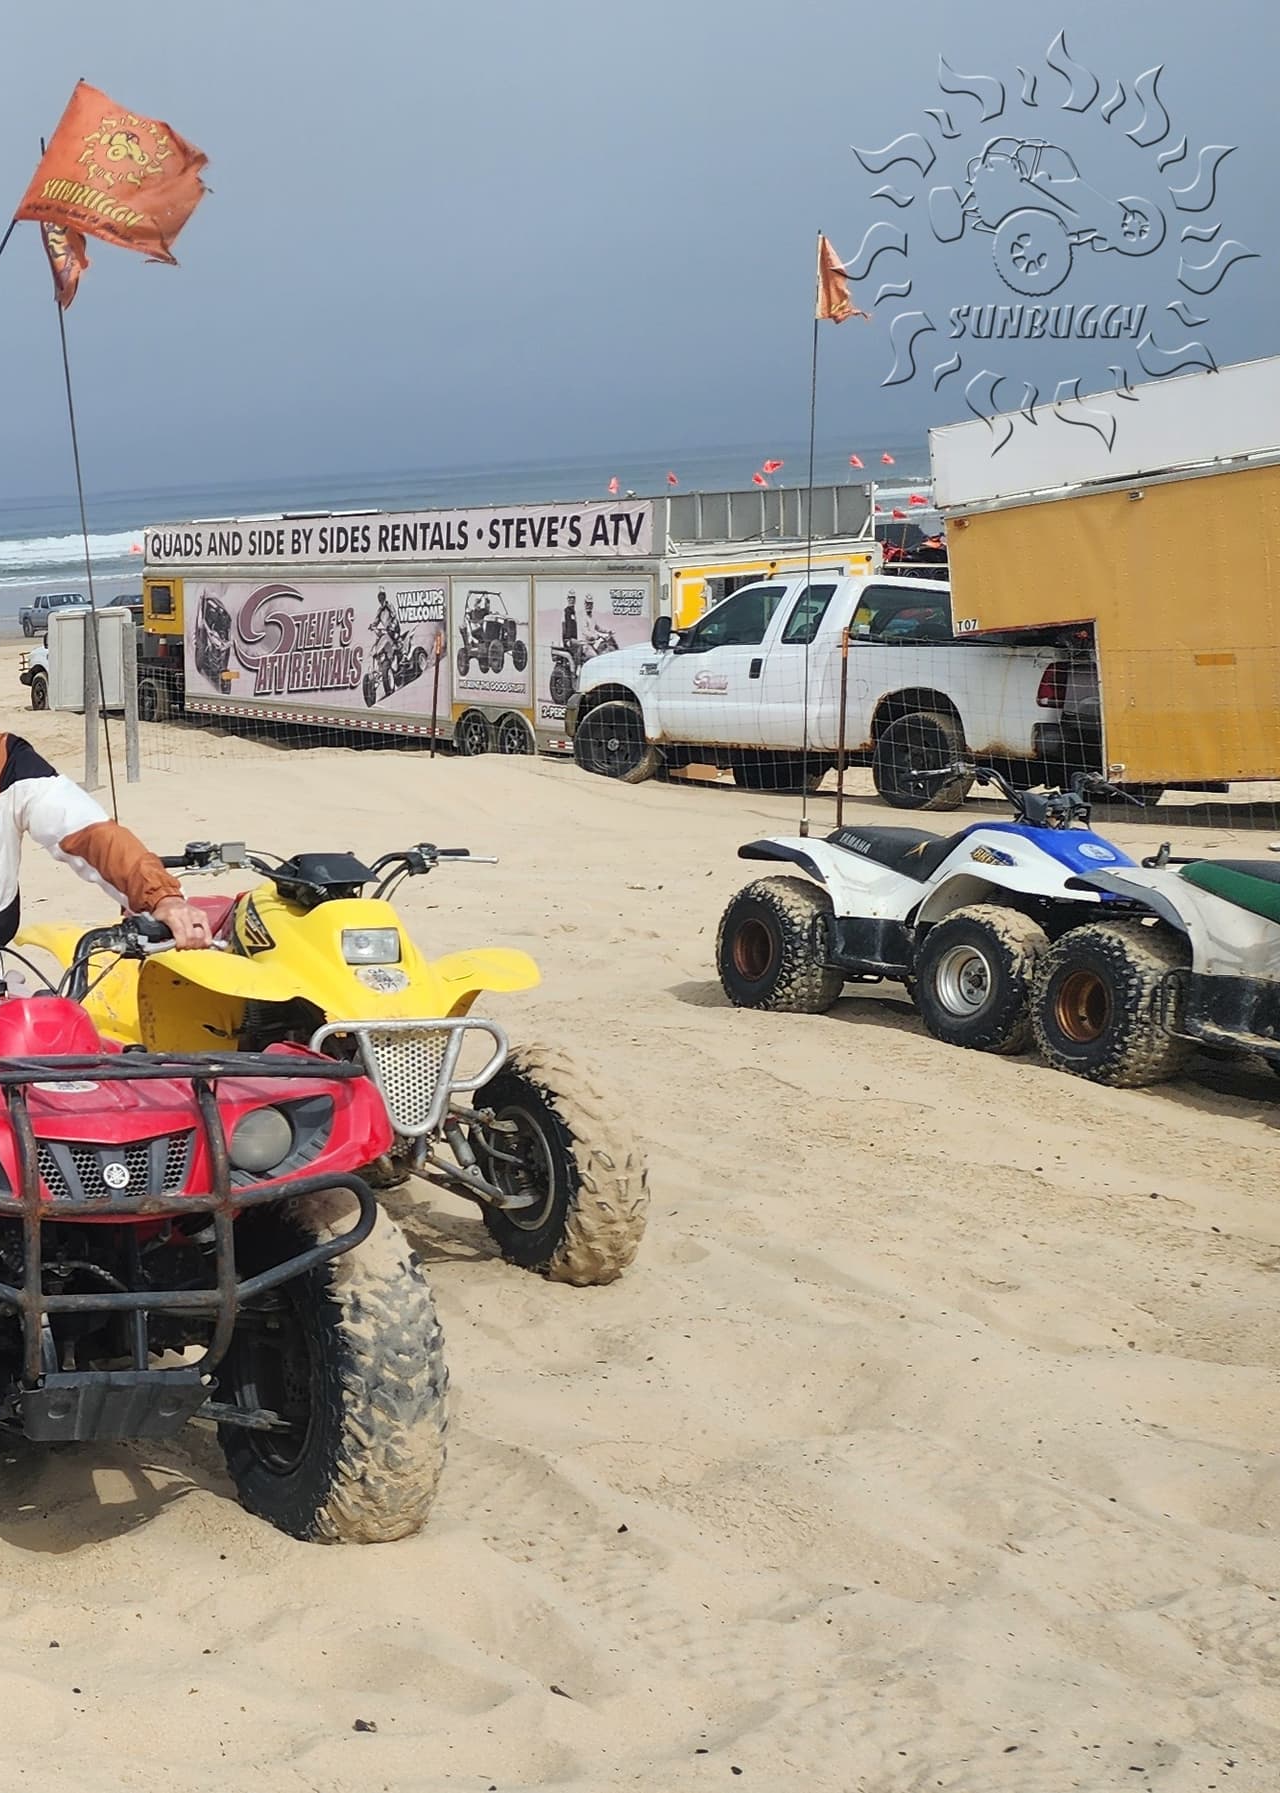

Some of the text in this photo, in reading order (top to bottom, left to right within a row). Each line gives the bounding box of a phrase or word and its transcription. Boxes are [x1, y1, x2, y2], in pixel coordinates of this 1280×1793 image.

[151, 512, 645, 558] QUADS AND SIDE BY SIDES RENTALS STEVE'S ATV
[397, 590, 444, 607] WALK-UPS
[398, 606, 444, 622] WELCOME
[957, 619, 977, 631] T07
[235, 584, 354, 668] STEVE'S
[255, 647, 363, 694] ATV RENTALS
[840, 832, 872, 854] YAMAHA
